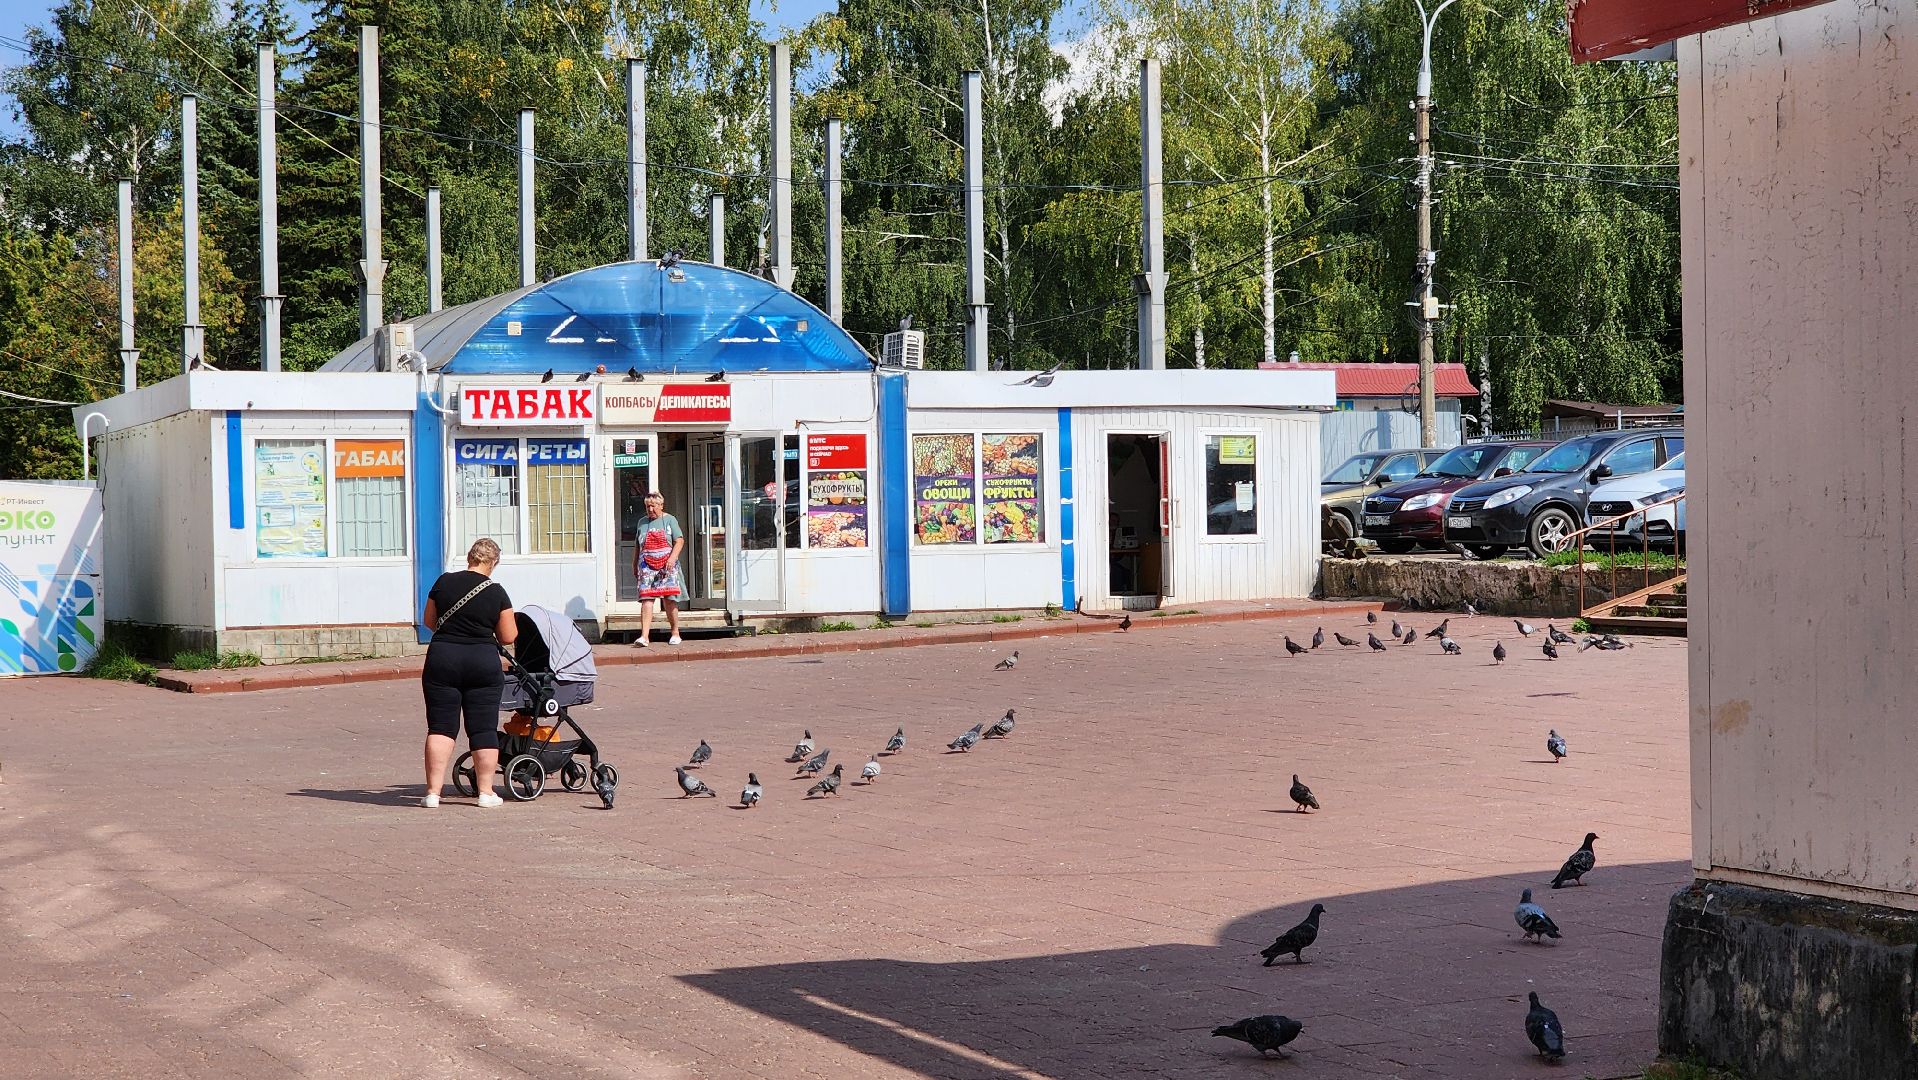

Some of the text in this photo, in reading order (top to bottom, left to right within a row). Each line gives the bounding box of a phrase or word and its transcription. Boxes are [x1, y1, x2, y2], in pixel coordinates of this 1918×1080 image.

[465, 390, 593, 419] ТАБАК
[660, 395, 731, 411] ДЕЛИКАТЕСЫ
[335, 450, 405, 467] ТАБАК
[615, 455, 647, 465] ОТКРЫТО
[985, 478, 1033, 486] СУХОФРУКТЫ
[812, 484, 863, 494] СУХОФРУКТЫ
[922, 487, 971, 501] ОВОЩИ
[983, 487, 1035, 499] ФРУКТЫ
